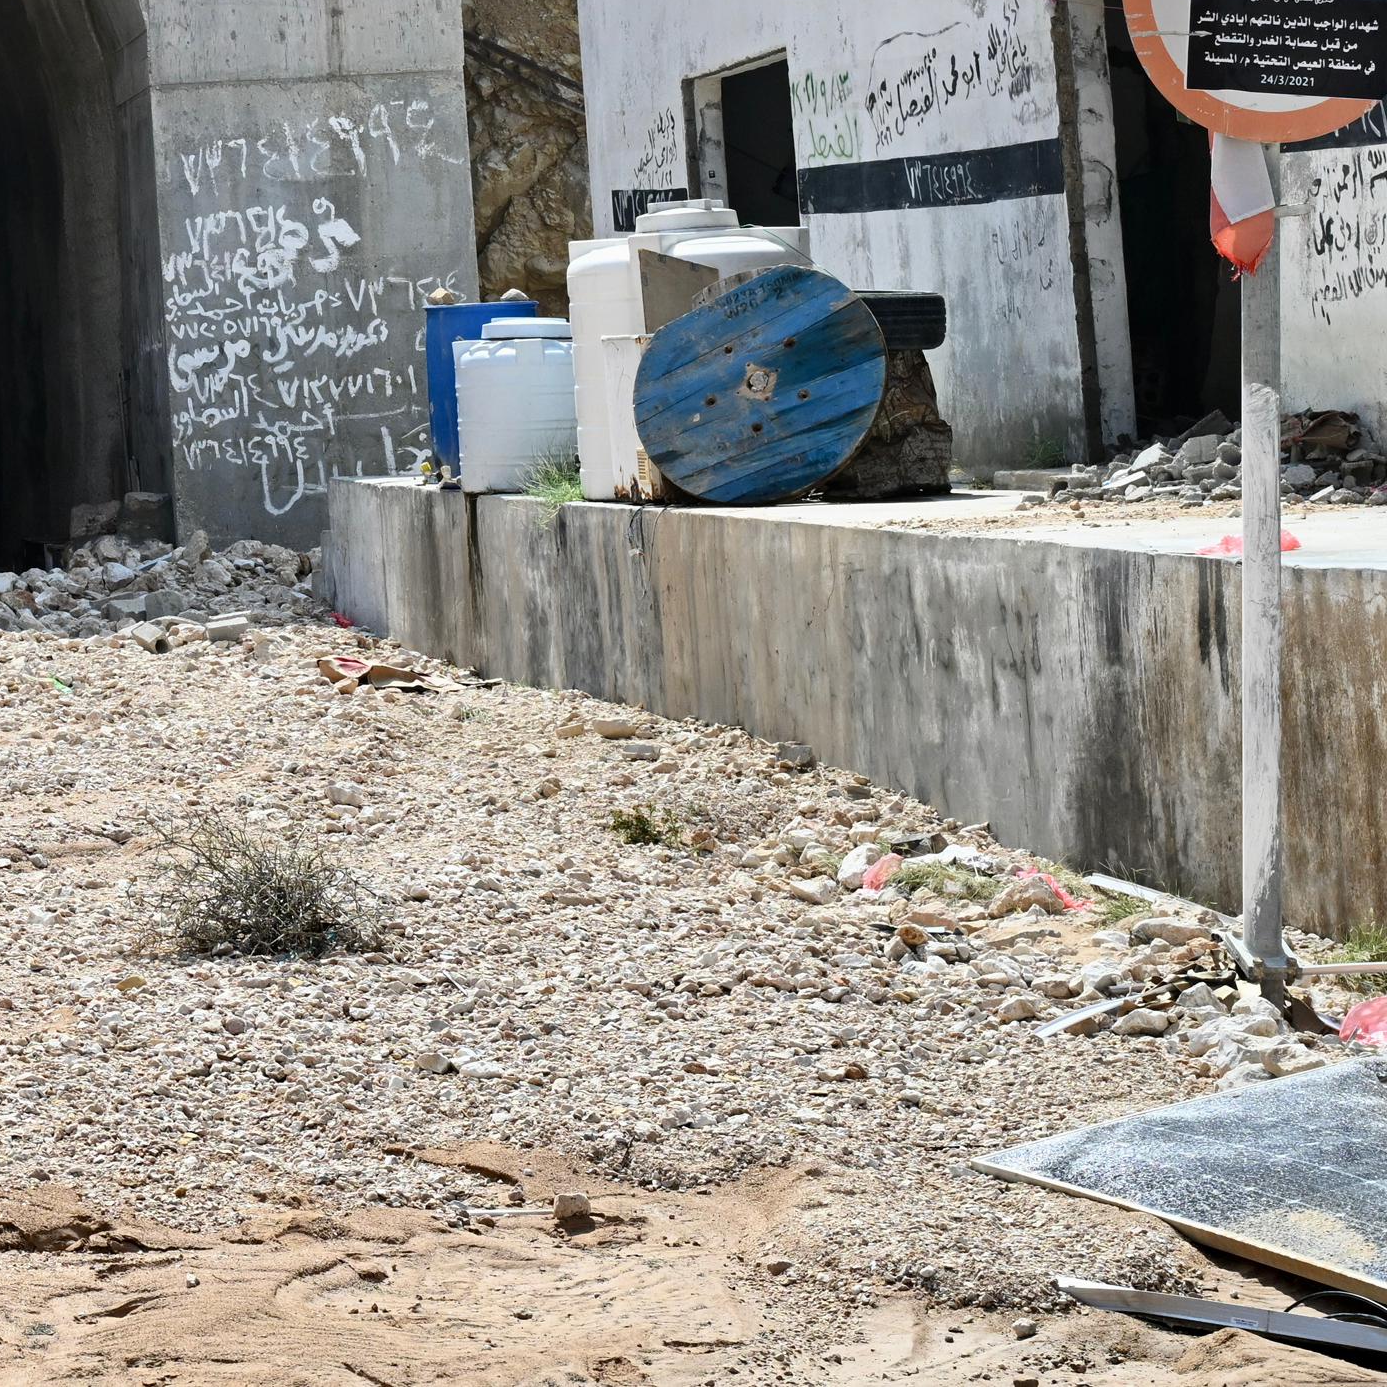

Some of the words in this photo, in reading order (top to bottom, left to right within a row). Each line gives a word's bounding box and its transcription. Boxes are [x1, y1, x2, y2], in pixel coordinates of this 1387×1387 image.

[1197, 11, 1219, 24] الشر
[1221, 13, 1248, 26] ايادي
[1250, 14, 1281, 27] نالتهم
[1283, 16, 1311, 28] الذين
[1313, 18, 1347, 29] الواجب
[1349, 20, 1379, 33] شهداء
[1214, 33, 1254, 46] والتقطع
[1256, 34, 1283, 46] الغدر
[1285, 35, 1318, 49] عصابة
[1320, 38, 1341, 51] قبل
[1342, 42, 1358, 52] من
[1204, 52, 1237, 64] المسيلة
[1253, 54, 1291, 67] التحتية
[1293, 58, 1326, 71] العيص
[1328, 58, 1362, 71] منطقة
[1364, 60, 1376, 75] في
[1260, 74, 1315, 87] 24/3/2021
